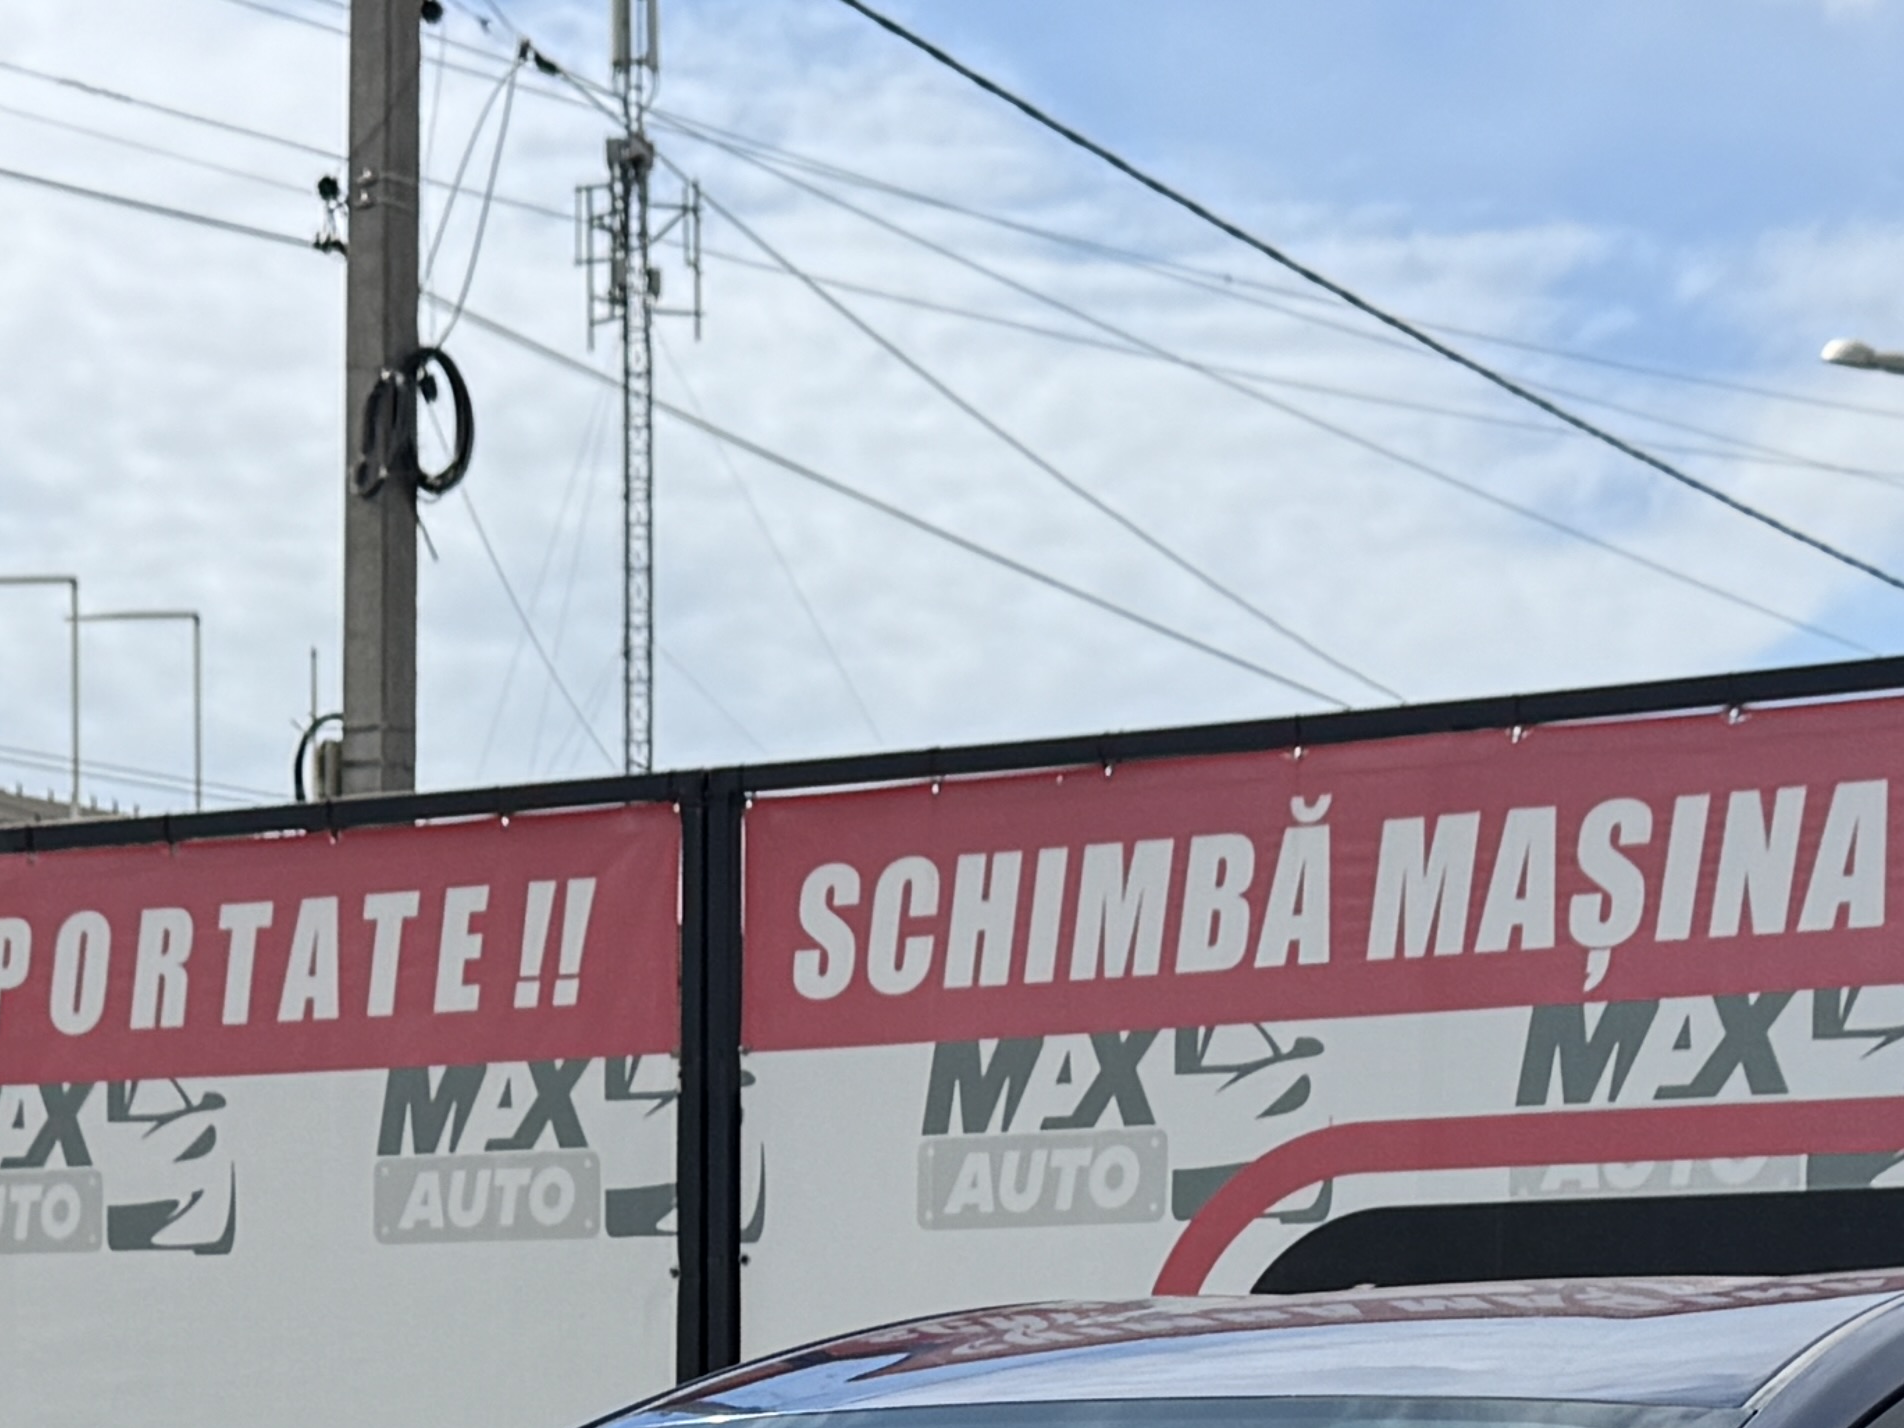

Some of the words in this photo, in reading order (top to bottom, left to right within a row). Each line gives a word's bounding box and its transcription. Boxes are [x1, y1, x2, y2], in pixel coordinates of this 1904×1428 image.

[792, 793, 1332, 1000] SCHIMBĂ
[1366, 778, 1889, 992] MAȘINA
[921, 1029, 1168, 1136] MAX
[1516, 990, 1799, 1107] MAX
[376, 1057, 598, 1156] MAX
[398, 1164, 576, 1230] AUTO
[943, 1143, 1141, 1216] AUTO
